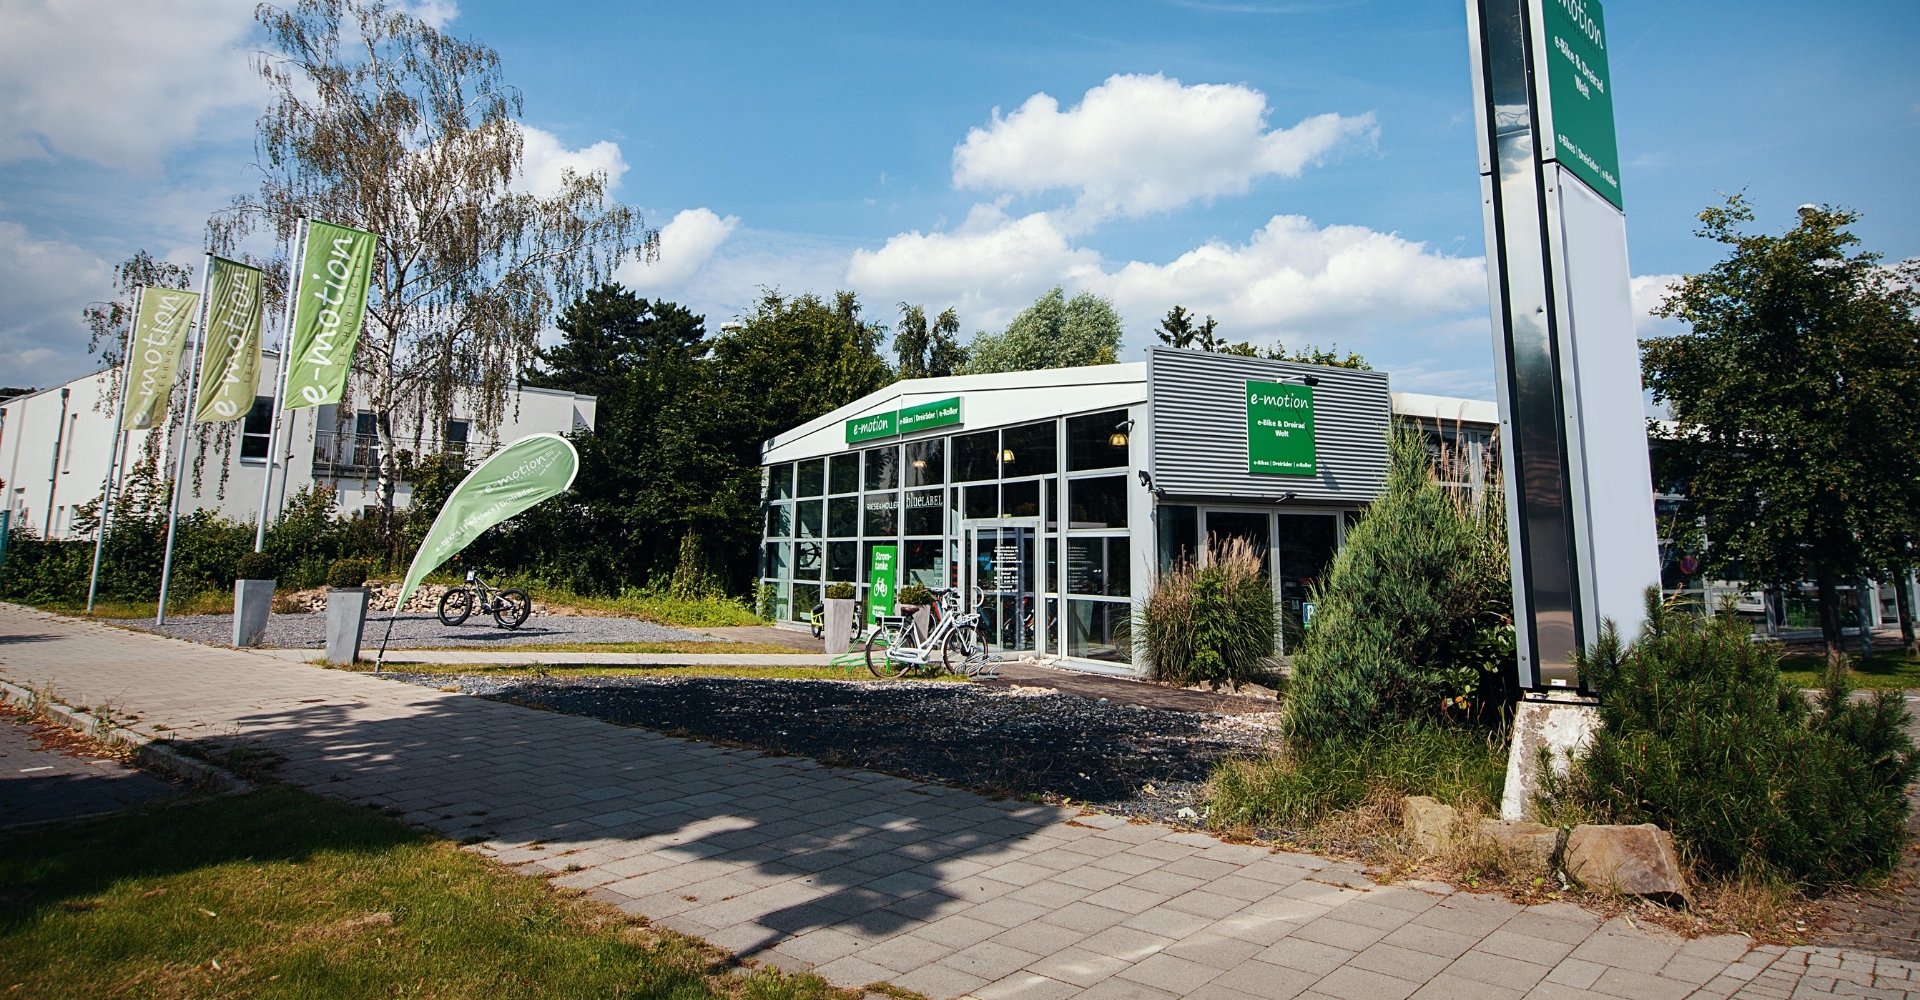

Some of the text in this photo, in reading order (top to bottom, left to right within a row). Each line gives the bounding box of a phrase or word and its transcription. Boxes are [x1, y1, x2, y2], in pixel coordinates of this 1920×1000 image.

[1554, 35, 1604, 94] e-Bike & Dreirad
[1574, 74, 1590, 100] Welt
[302, 236, 353, 404] e-motion
[337, 254, 364, 367] TECHNOLOGIES
[214, 271, 250, 416] e-motion
[133, 294, 180, 426] e-motion
[1250, 392, 1309, 409] e-motion
[853, 415, 888, 435] e-motion
[900, 406, 958, 425] e-Bikes Dreiräder e-Roller
[1257, 418, 1306, 429] e-Bike & Dreirad
[1274, 429, 1289, 437] Welt
[484, 455, 546, 493] e-motion
[435, 530, 461, 552] e-Bikes
[463, 507, 496, 530] Pedelecs
[874, 561, 888, 570] tanke
[875, 551, 892, 561] Strom-
[1307, 604, 1314, 620] P
